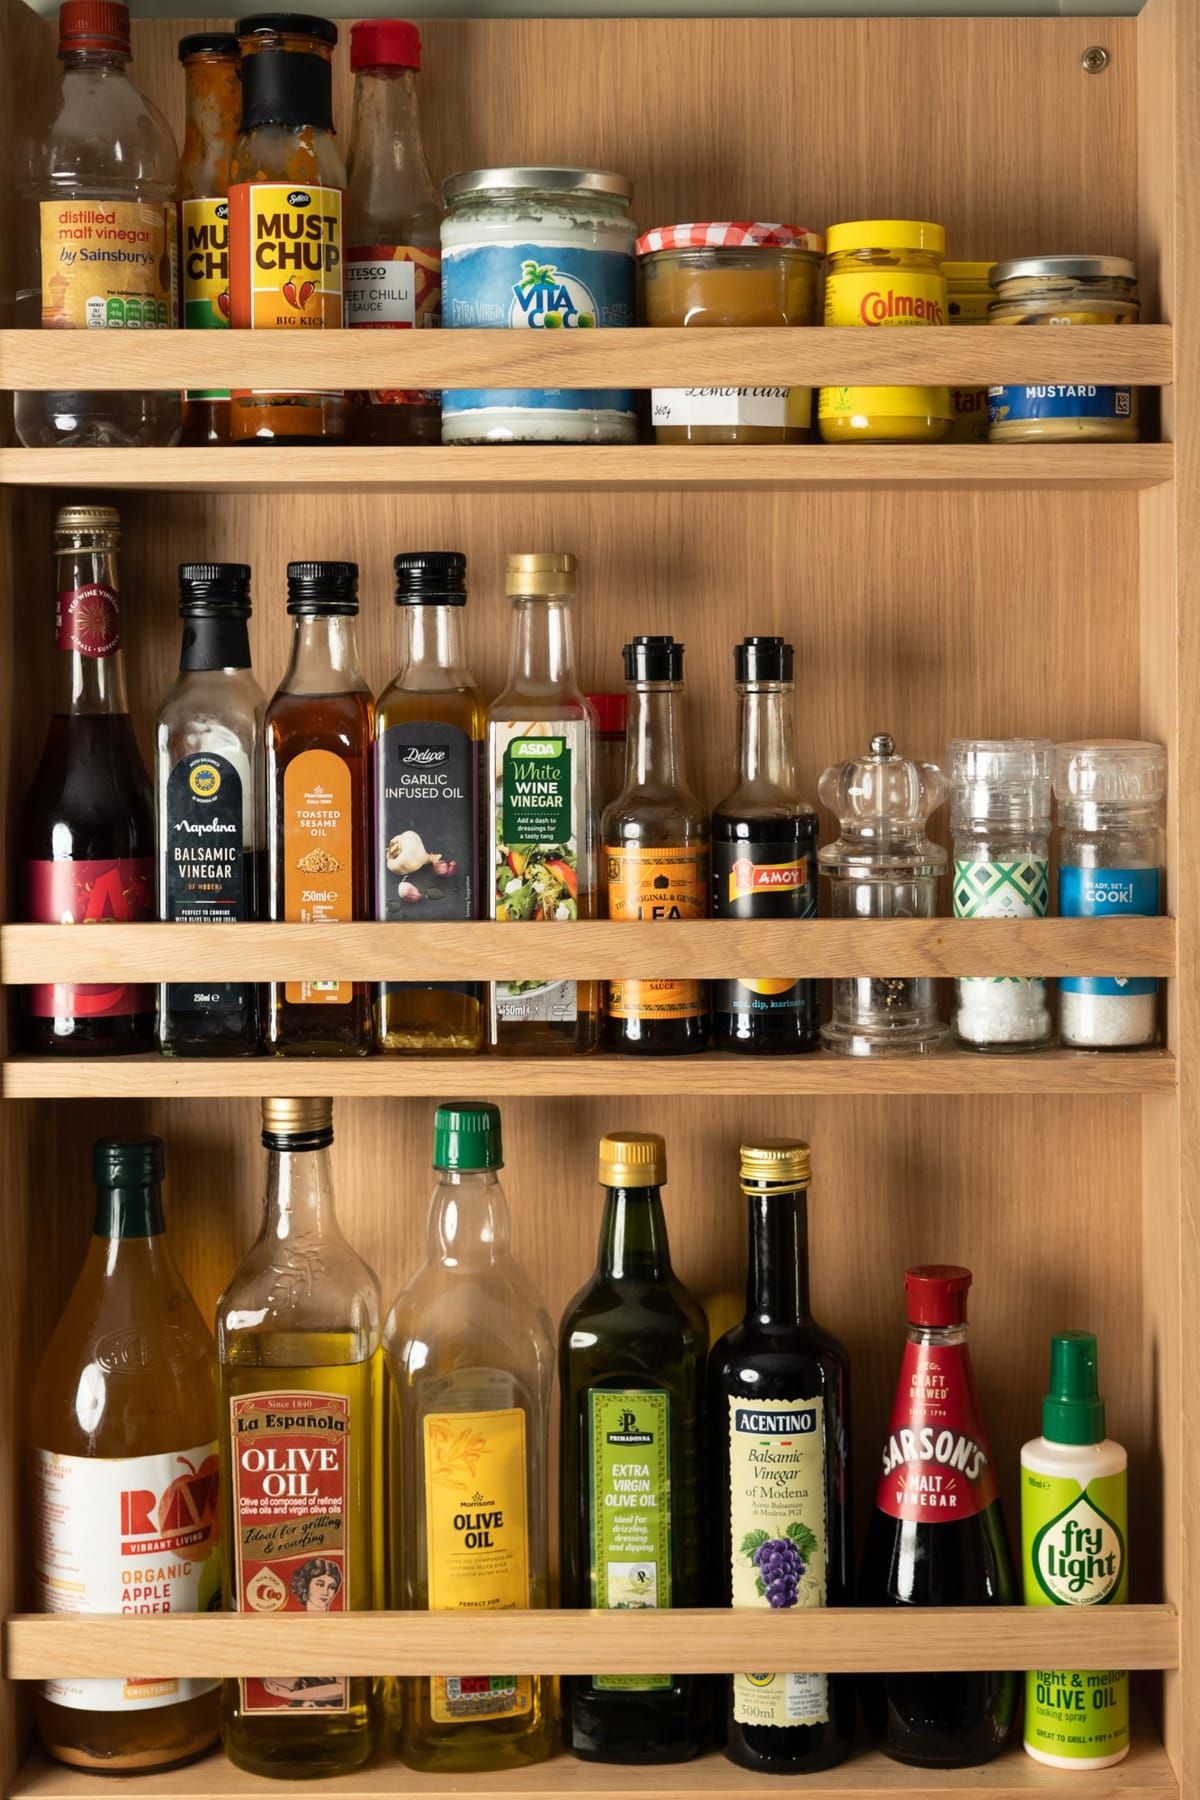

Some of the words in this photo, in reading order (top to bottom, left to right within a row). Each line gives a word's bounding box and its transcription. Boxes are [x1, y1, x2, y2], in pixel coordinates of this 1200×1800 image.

[59, 211, 116, 224] distilled
[59, 226, 93, 239] malt
[95, 227, 150, 243] vinegar
[257, 213, 338, 242] MUST
[187, 225, 228, 250] MU
[60, 247, 77, 265] by
[80, 248, 155, 265] Sainsbury's
[256, 242, 340, 272] CHUP
[187, 252, 228, 280] CH
[350, 267, 387, 277] TESCO
[345, 290, 366, 302] EET
[369, 289, 408, 300] CHILLI
[512, 285, 575, 312] VITA
[352, 302, 383, 311] SAUCE
[860, 290, 944, 327] Colman's
[276, 317, 296, 326] BIG
[1026, 385, 1097, 398] MUSTARD
[953, 391, 987, 413] tar
[79, 590, 98, 600] WINE
[403, 747, 446, 765] Deluxe
[518, 743, 555, 755] ASDA
[509, 761, 563, 780] White
[401, 774, 448, 785] GARLIC
[385, 787, 439, 799] INFUSED
[442, 787, 464, 799] OIL
[515, 782, 558, 794] WINE
[510, 795, 563, 807] VINEGAR
[173, 817, 237, 837] Napolina
[174, 847, 236, 861] BALSAMIC
[178, 864, 232, 878] VINEGAR
[758, 872, 799, 884] AMOY
[302, 891, 326, 901] 250ml
[1086, 884, 1133, 902] COOK!
[752, 999, 769, 1010] dip,
[268, 1400, 290, 1408] Since
[238, 1418, 259, 1433] La
[265, 1414, 345, 1432] Española
[740, 1414, 811, 1432] ACENTINO
[241, 1448, 340, 1473] OLIVE
[748, 1449, 803, 1463] Balsamic
[882, 1427, 985, 1480] SARSON'S
[612, 1464, 649, 1477] EXTRA
[754, 1465, 802, 1487] Vinegar
[262, 1473, 319, 1497] OIL
[613, 1479, 650, 1492] VIRGIN
[909, 1475, 943, 1492] MALT
[745, 1487, 758, 1498] of
[760, 1487, 809, 1499] Modena
[896, 1491, 957, 1507] VINEGAR
[240, 1497, 259, 1506] Olive
[260, 1497, 269, 1506] oil
[270, 1498, 307, 1507] composed
[317, 1496, 342, 1506] refined
[605, 1494, 637, 1507] OLIVE
[639, 1494, 657, 1507] OIL
[240, 1505, 258, 1515] olive
[259, 1505, 272, 1515] oils
[273, 1506, 288, 1514] and
[289, 1505, 309, 1516] virgin
[310, 1504, 328, 1514] olive
[329, 1505, 342, 1514] oils
[453, 1511, 504, 1531] OLIVE
[614, 1515, 634, 1524] Ideal
[635, 1515, 648, 1525] for
[244, 1528, 278, 1544] Ideal
[301, 1515, 342, 1532] grilling
[464, 1532, 494, 1549] OIL
[614, 1534, 648, 1544] dressing
[1059, 1520, 1103, 1558] fry
[130, 1540, 172, 1553] VIBRANT
[264, 1542, 274, 1553] &
[608, 1543, 625, 1551] and
[625, 1543, 654, 1553] dipping
[122, 1562, 192, 1584] ORGANIC
[1048, 1544, 1116, 1593] light
[122, 1584, 171, 1602] APPLE
[1037, 1670, 1067, 1687] light
[1071, 1673, 1083, 1688] &
[1036, 1684, 1086, 1710] OLIVE
[1093, 1687, 1117, 1709] OIL
[741, 1705, 775, 1719] 500ml
[1036, 1706, 1063, 1722] cooking
[1065, 1713, 1087, 1723] spray
[1036, 1728, 1055, 1739] GREAT
[1057, 1734, 1065, 1742] TO
